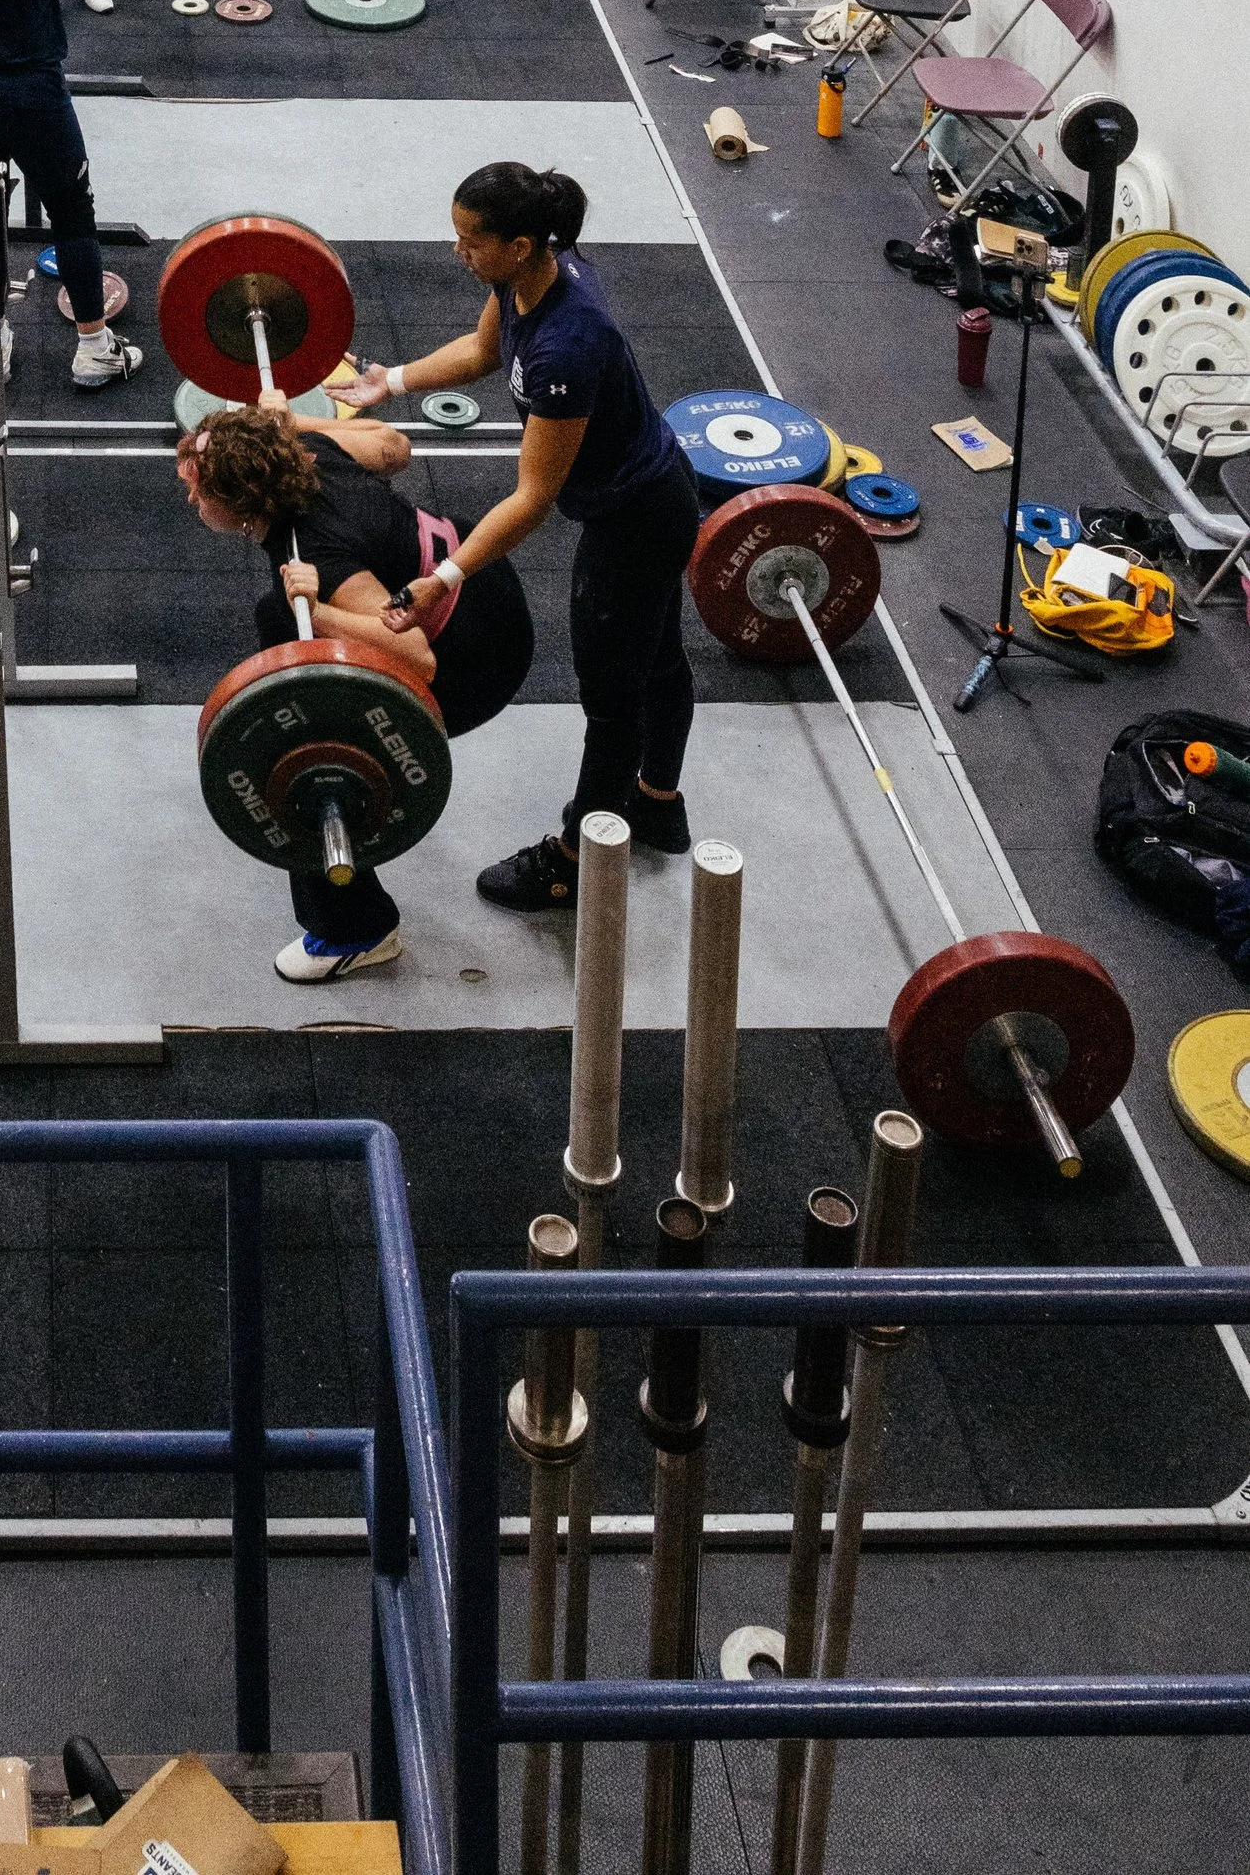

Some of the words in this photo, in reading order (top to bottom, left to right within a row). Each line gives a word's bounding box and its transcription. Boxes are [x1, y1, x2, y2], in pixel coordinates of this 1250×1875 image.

[689, 399, 762, 416] ELEIKO
[723, 455, 802, 474] ELEIKO
[718, 524, 772, 592] ELEIKO
[273, 707, 300, 730] 10
[364, 705, 429, 777] ELEIKO
[227, 769, 291, 849] ELEIKO
